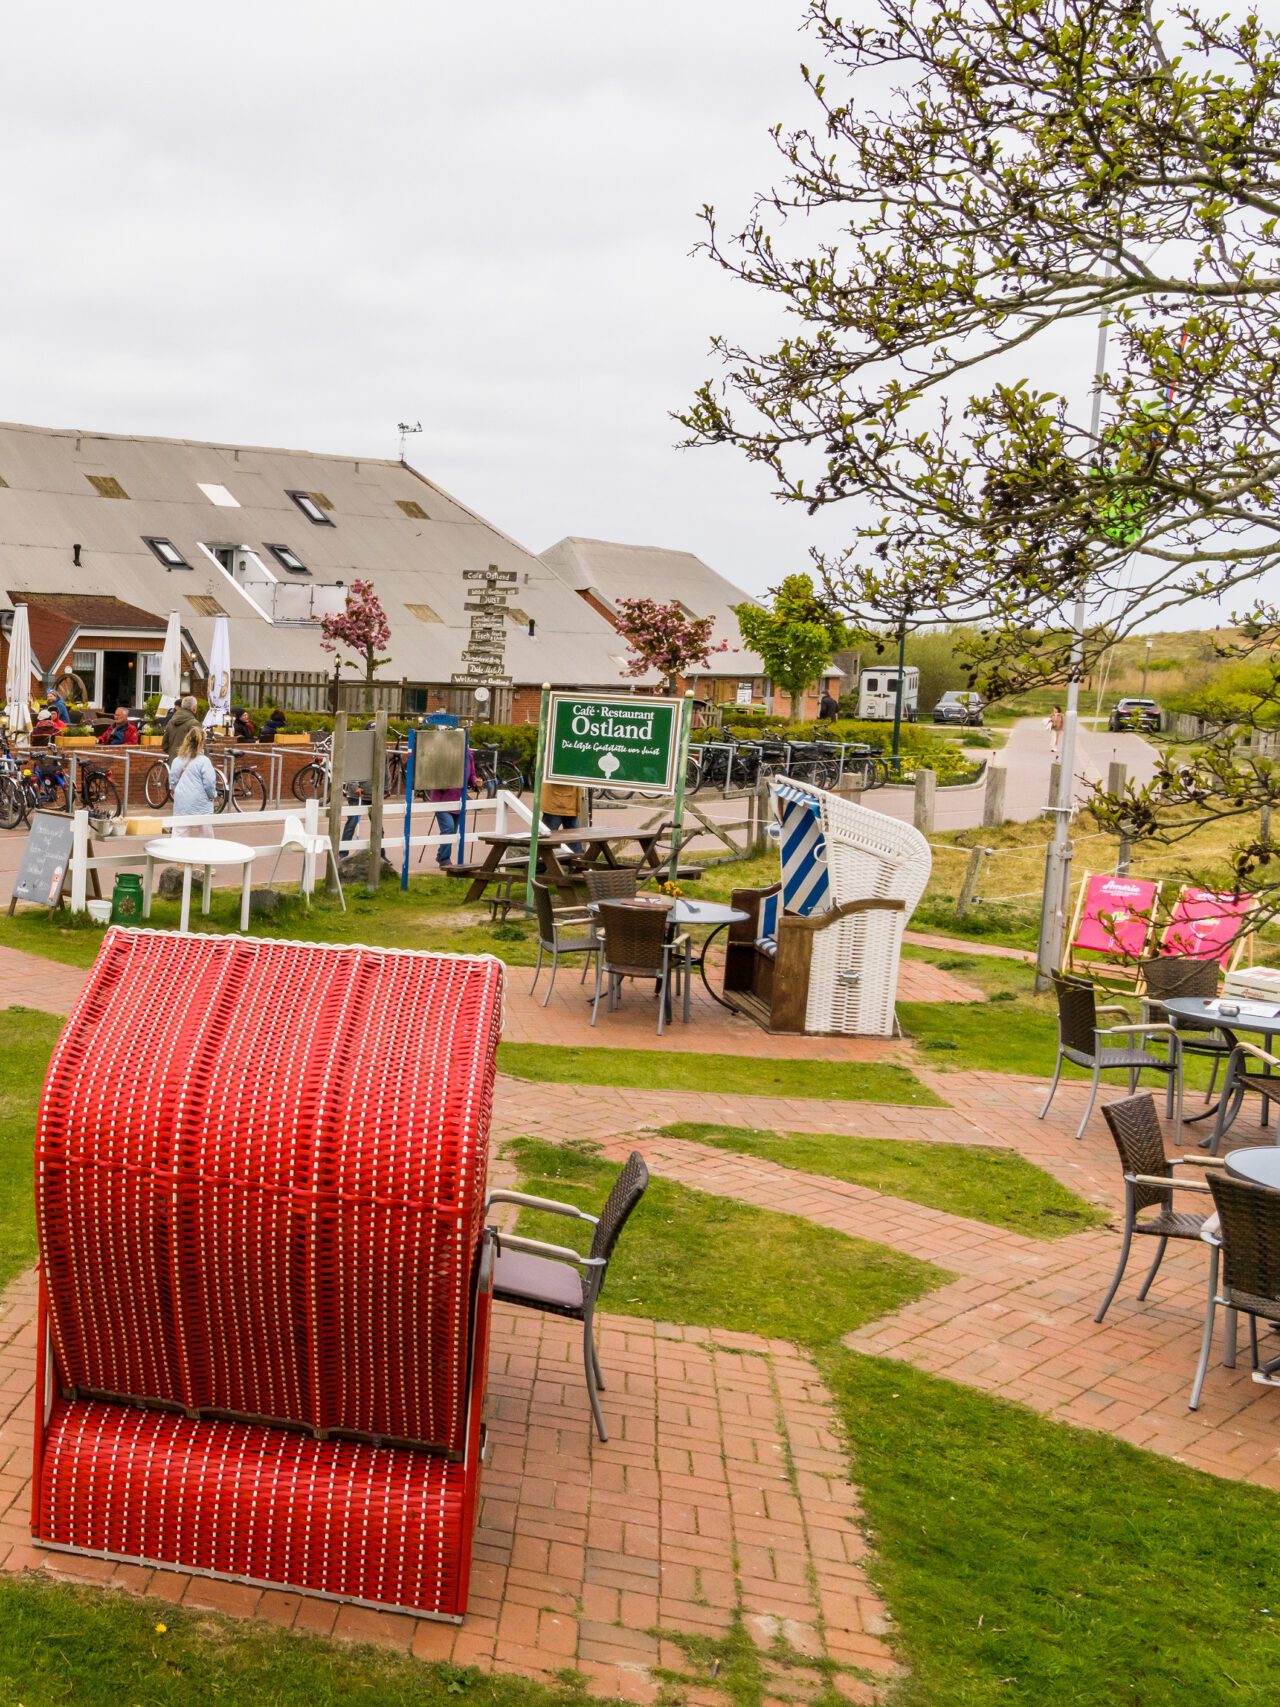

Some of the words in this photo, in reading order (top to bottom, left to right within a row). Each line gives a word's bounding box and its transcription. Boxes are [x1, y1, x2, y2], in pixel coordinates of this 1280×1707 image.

[573, 705, 595, 717] Café
[601, 707, 654, 720] Restaurant
[572, 716, 652, 740] Ostland
